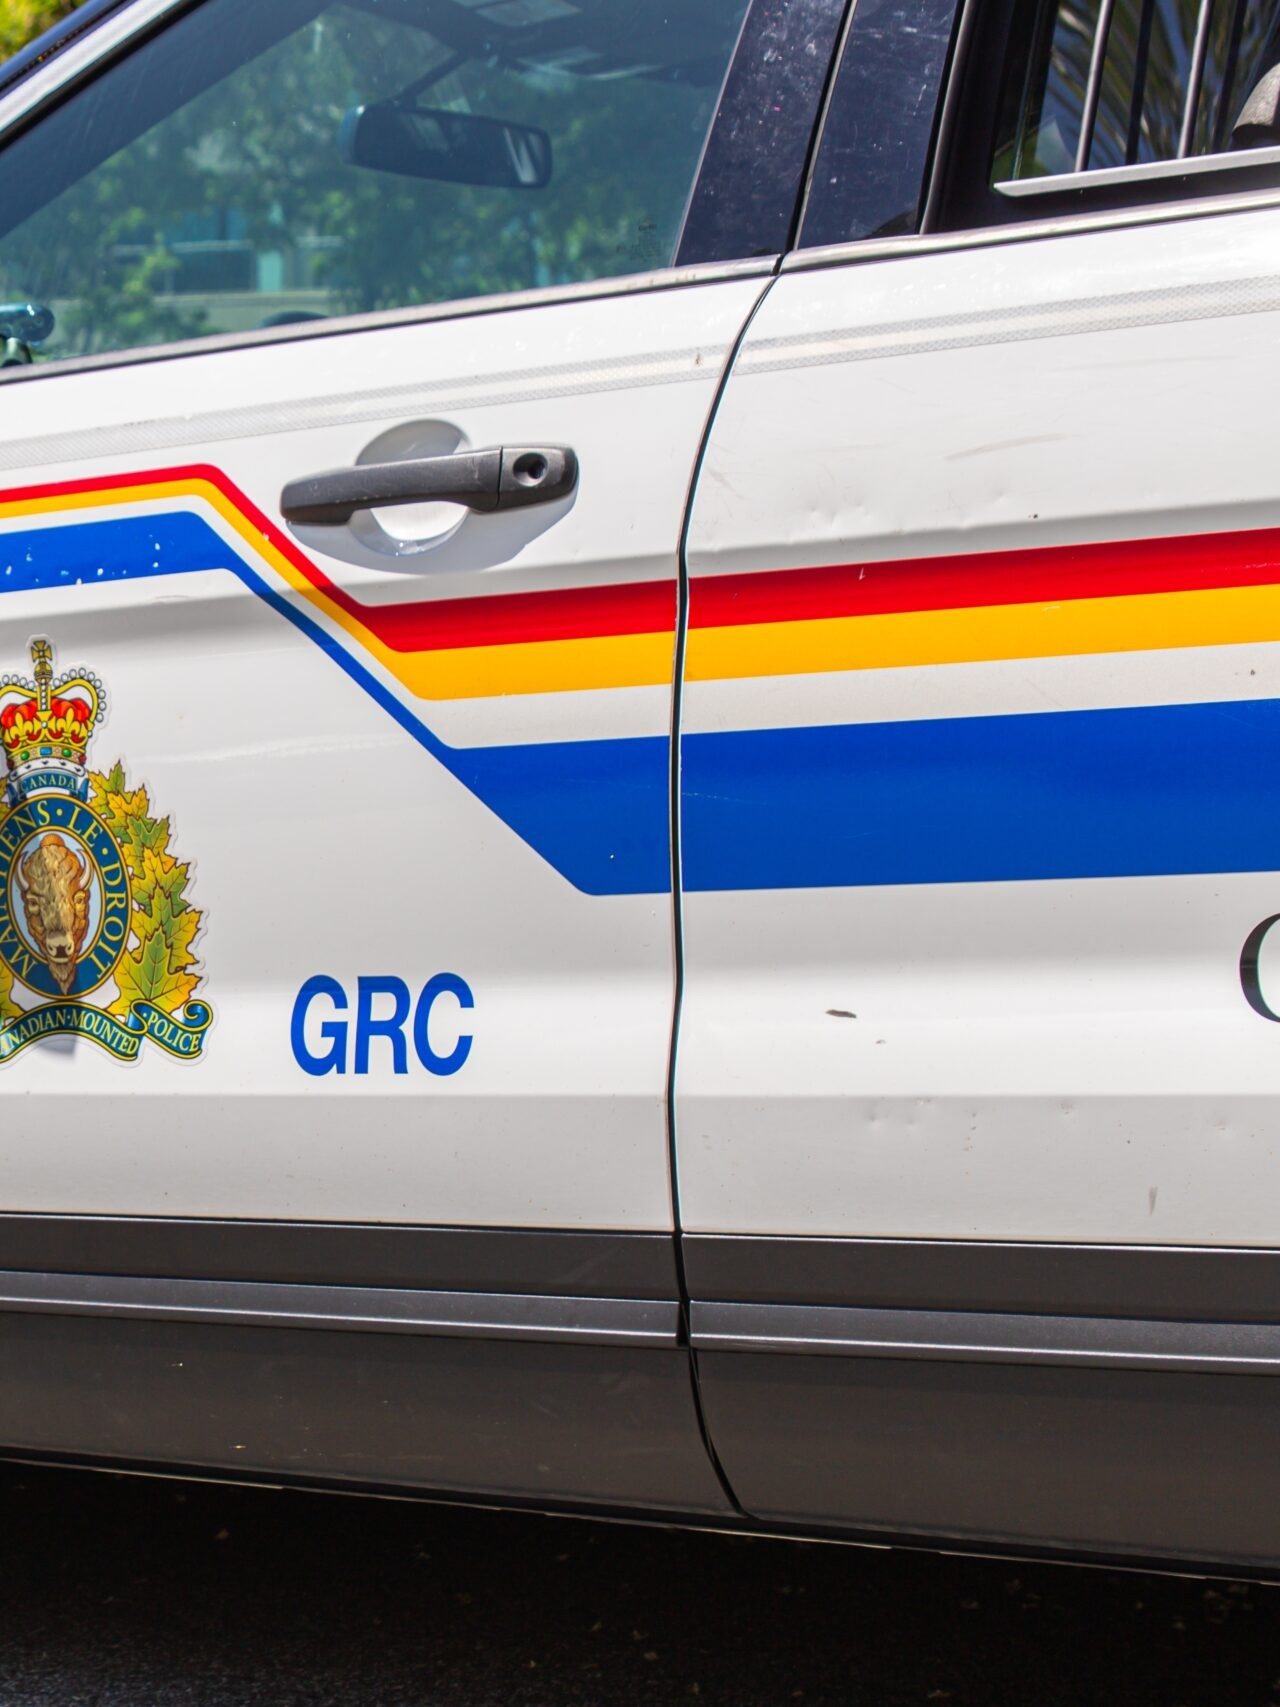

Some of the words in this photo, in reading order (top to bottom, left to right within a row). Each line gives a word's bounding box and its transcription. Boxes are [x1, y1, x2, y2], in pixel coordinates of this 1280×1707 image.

[21, 773, 77, 792] CANADA
[67, 806, 103, 847] LE
[89, 861, 126, 979] DROIT
[71, 1009, 139, 1055] MOUNTED
[147, 1011, 201, 1051] POLICE
[290, 973, 474, 1076] GRC
